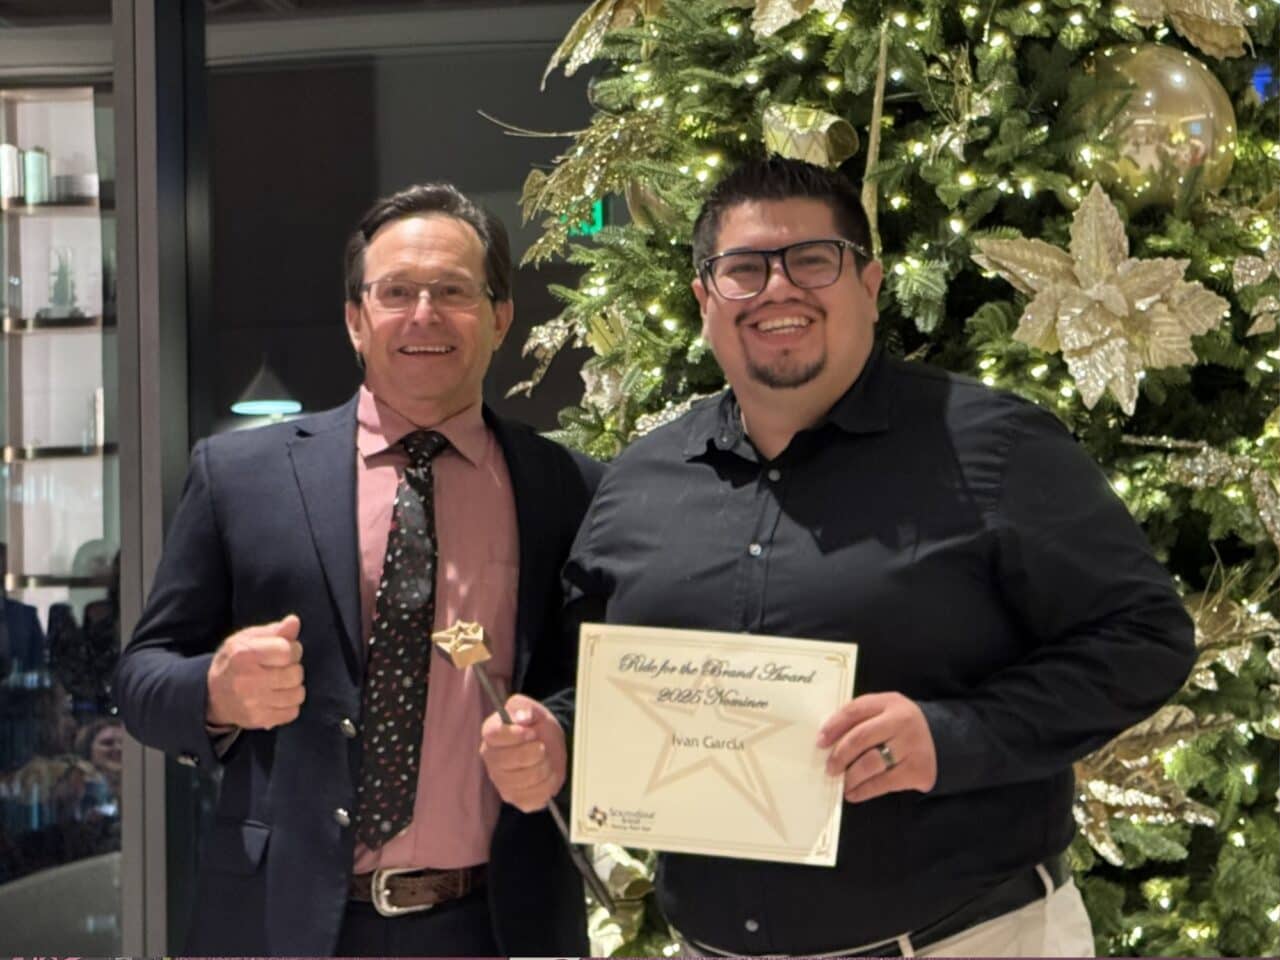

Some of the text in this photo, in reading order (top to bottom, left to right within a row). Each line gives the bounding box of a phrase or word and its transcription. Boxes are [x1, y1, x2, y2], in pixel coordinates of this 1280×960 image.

[618, 653, 817, 684] Ride for the Brand Award
[656, 685, 768, 709] 2025 Nominee
[672, 732, 699, 747] Ivan
